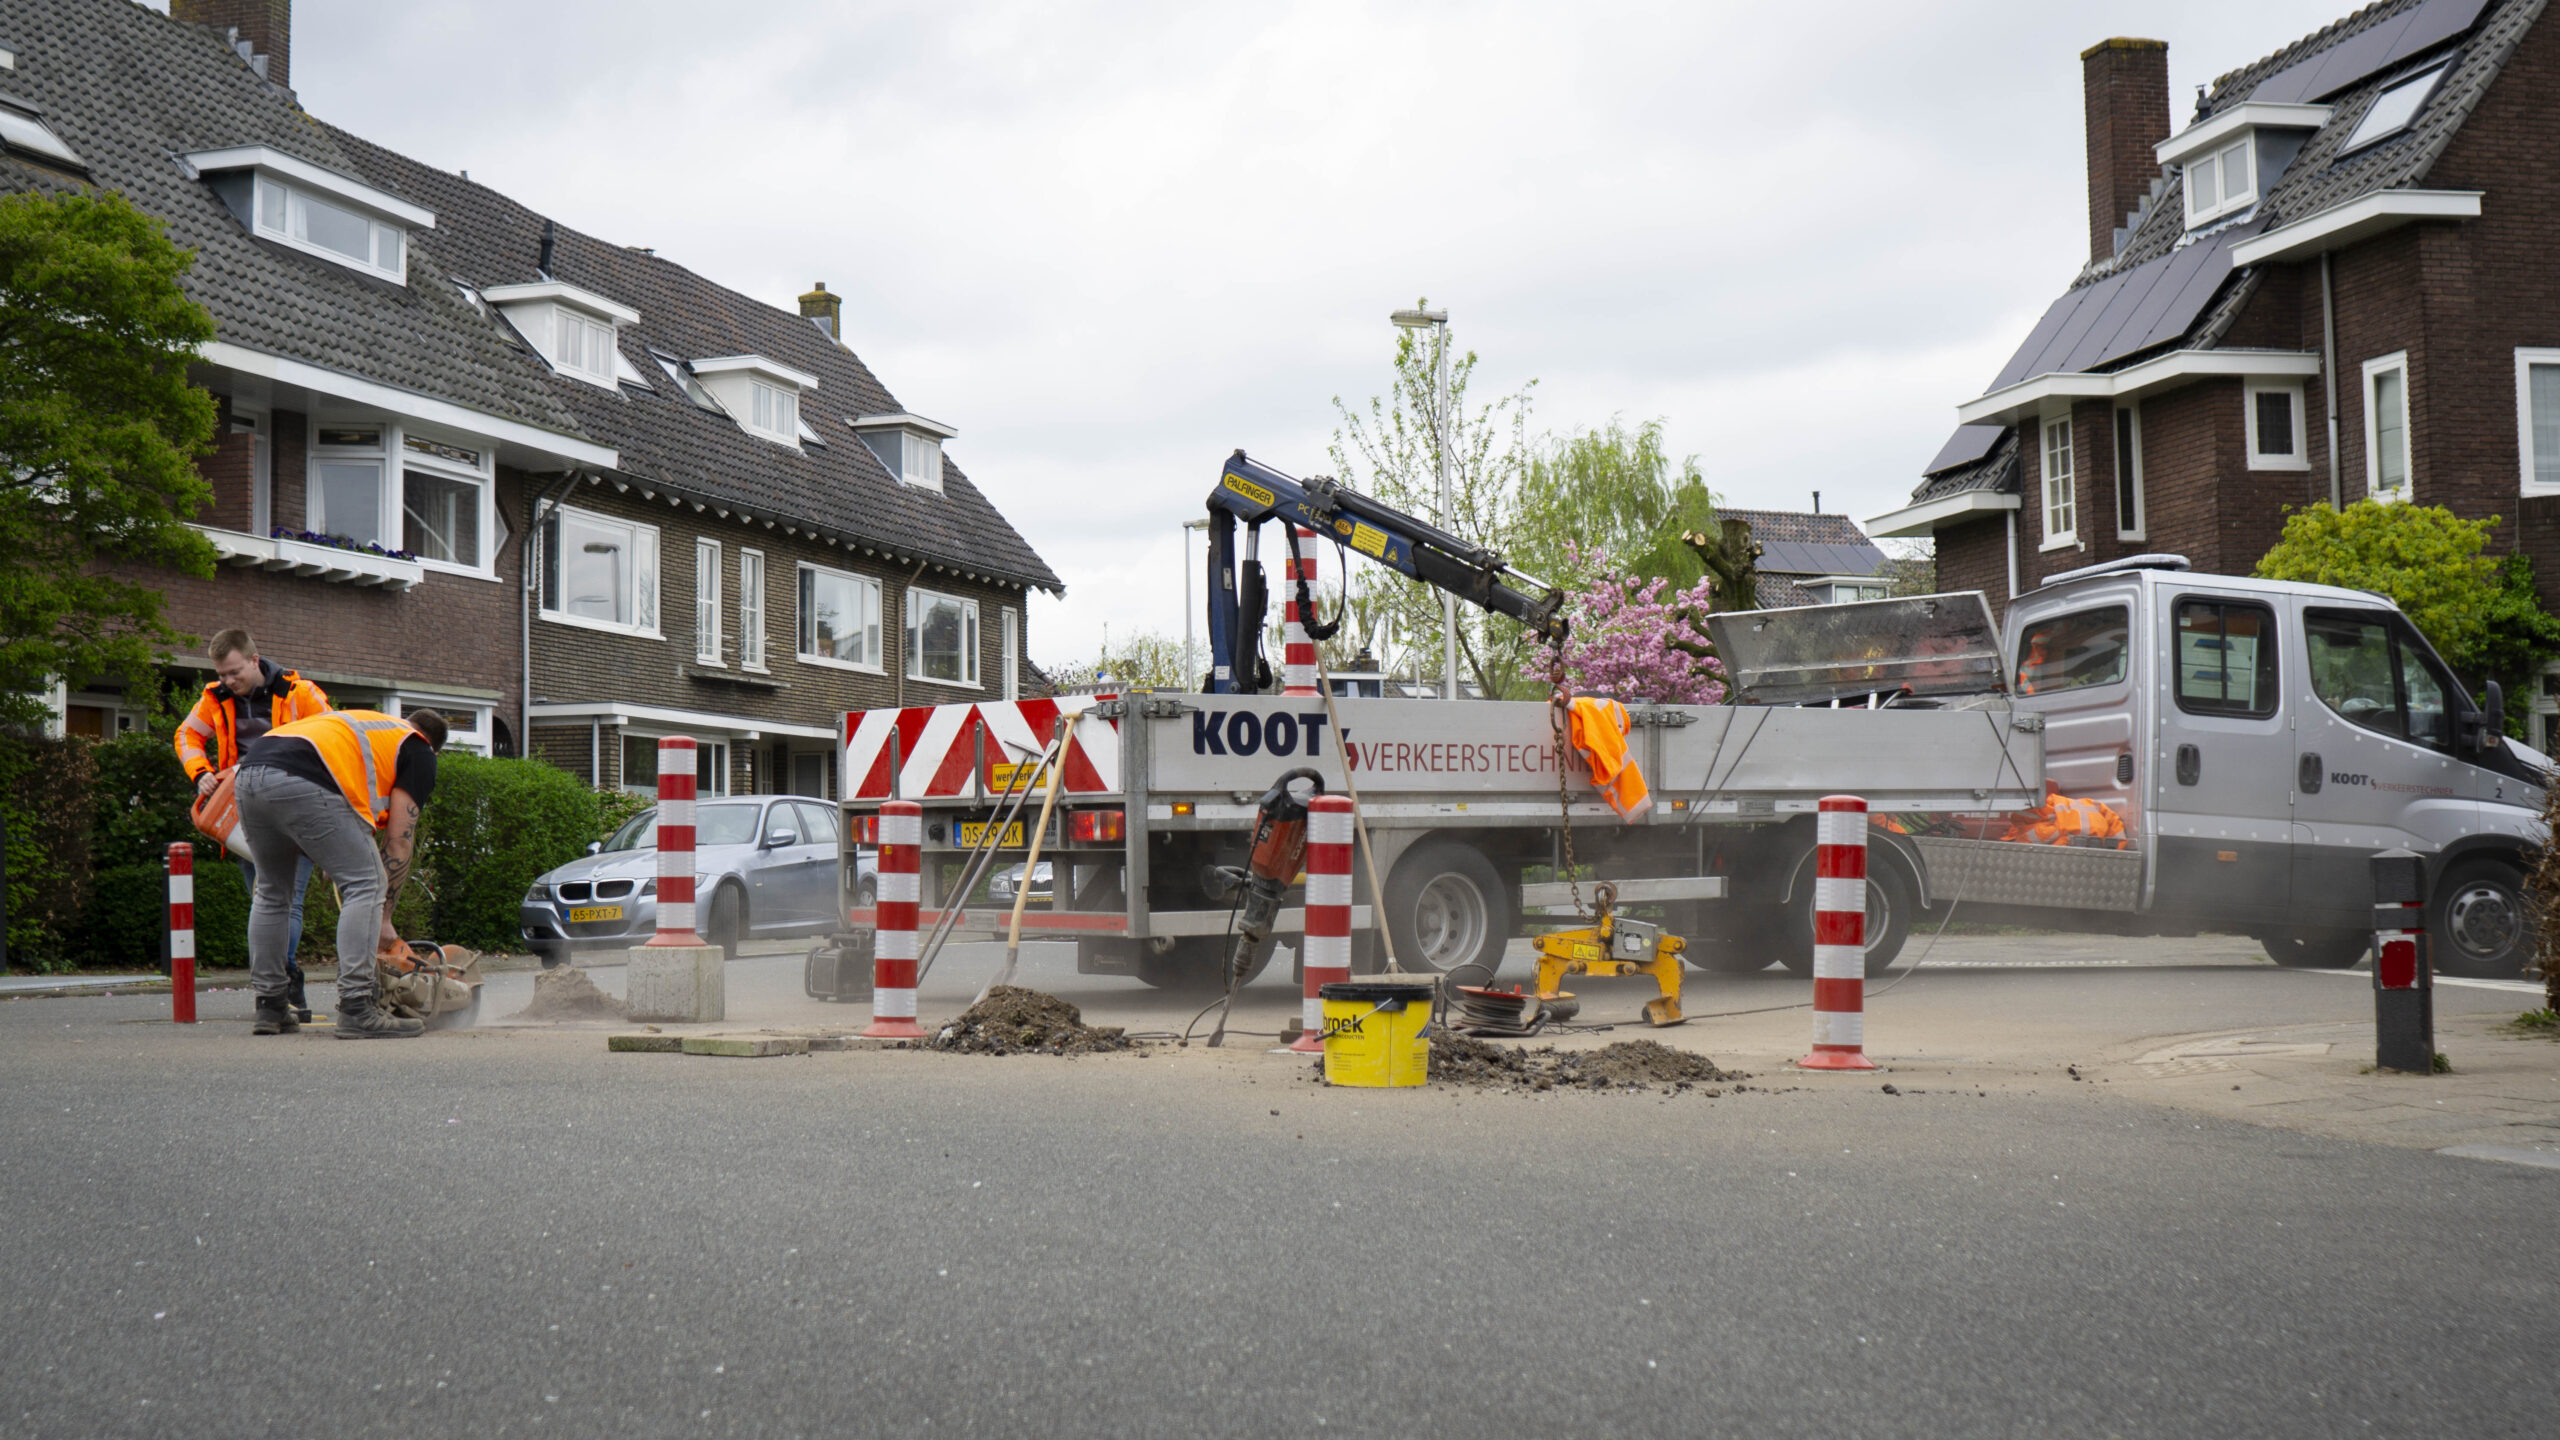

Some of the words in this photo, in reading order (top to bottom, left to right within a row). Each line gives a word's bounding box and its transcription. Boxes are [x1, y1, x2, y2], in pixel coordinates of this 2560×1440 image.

[1227, 476, 1271, 502] PALFINGER
[1193, 711, 1327, 756] KOOT
[1362, 742, 1593, 772] VERKEERSTECHNI
[2331, 773, 2368, 785] KOOT
[2495, 787, 2503, 798] 2
[574, 908, 617, 920] 65-PXT-7
